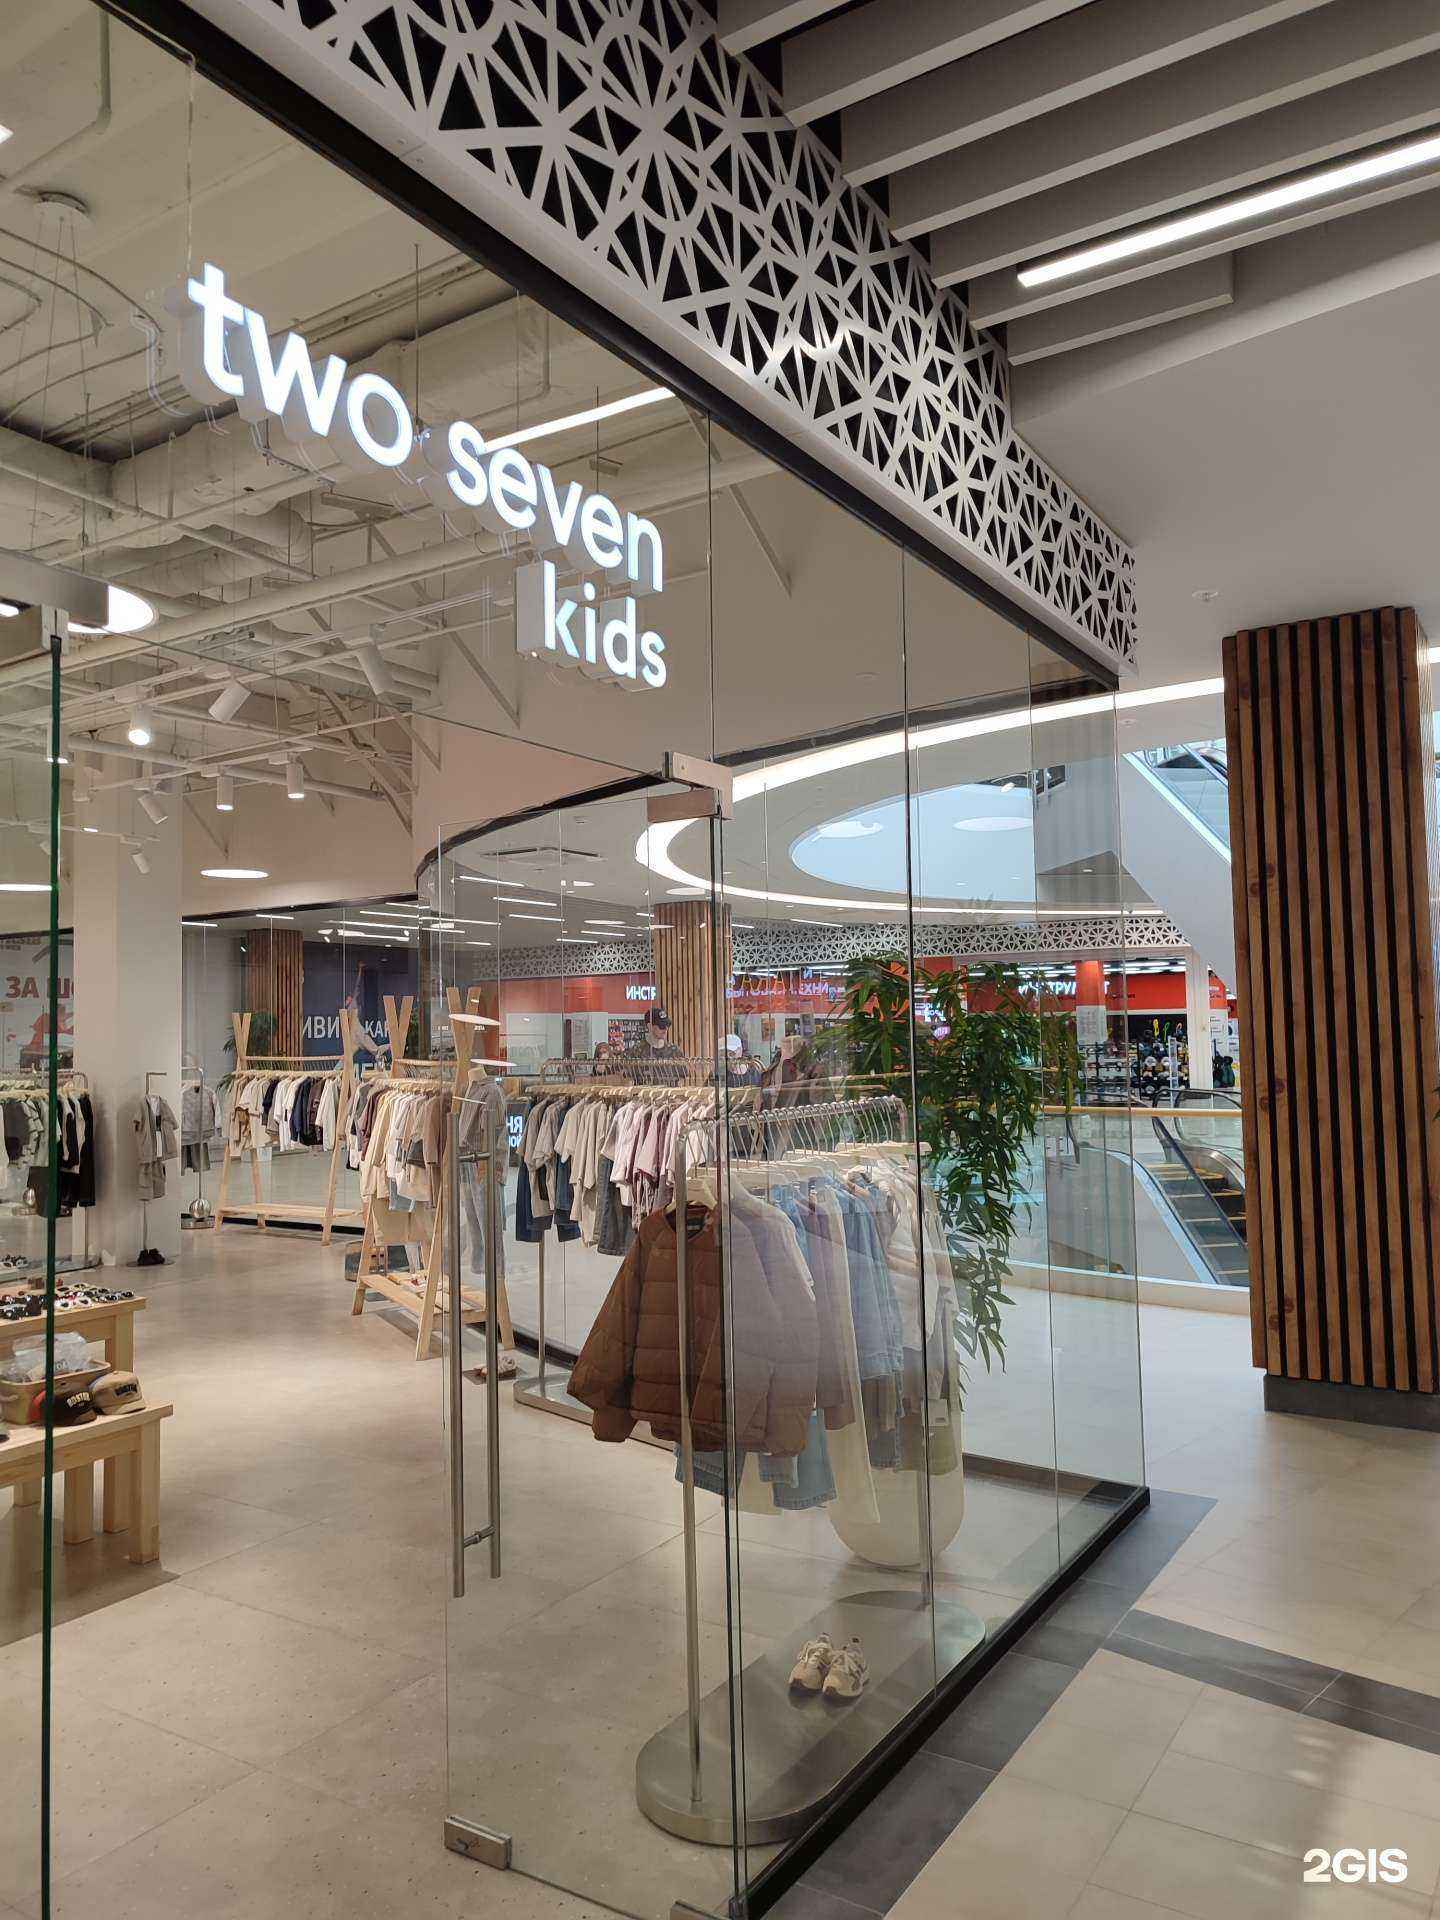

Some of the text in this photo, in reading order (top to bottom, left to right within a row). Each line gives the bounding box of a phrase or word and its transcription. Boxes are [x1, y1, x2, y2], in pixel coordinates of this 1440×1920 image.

[187, 261, 664, 593] two seven
[542, 559, 667, 689] kids
[5, 976, 74, 998] ЗА Ш
